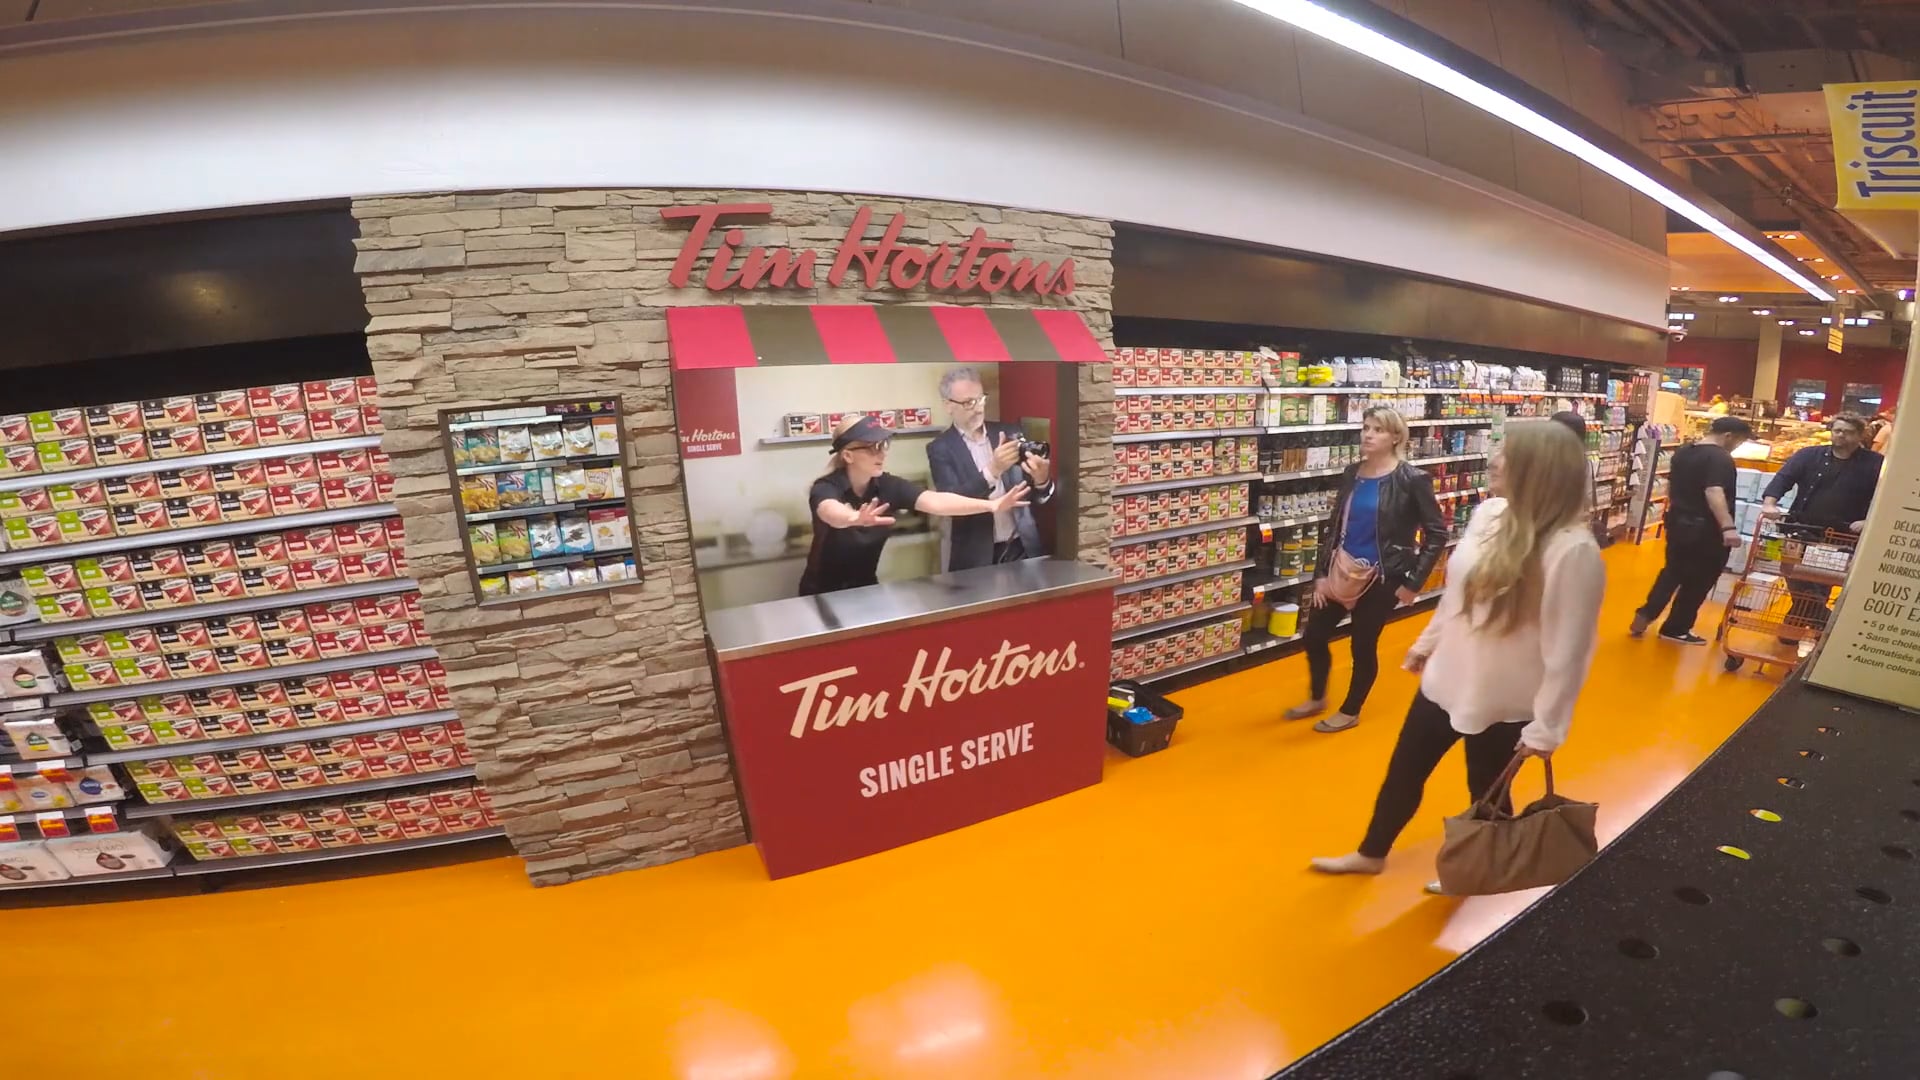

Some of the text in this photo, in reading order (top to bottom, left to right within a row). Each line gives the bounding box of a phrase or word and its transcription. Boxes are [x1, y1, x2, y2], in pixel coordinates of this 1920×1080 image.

[1846, 90, 1920, 197] Triscuit
[659, 203, 1075, 296] Tim Hortons
[692, 429, 735, 442] Hortons
[1894, 520, 1920, 534] DÉLIC
[1889, 535, 1907, 546] CES
[1883, 549, 1898, 560] AU
[1872, 581, 1911, 601] VOUS
[1863, 598, 1905, 618] GOÛT
[1887, 624, 1899, 633] de
[1865, 632, 1890, 644] Sans
[1859, 644, 1914, 662] Aromatisés
[1853, 656, 1885, 668] Aucun
[779, 639, 1078, 739] Tim Hortons
[859, 722, 1035, 798] SINGLE SERVE
